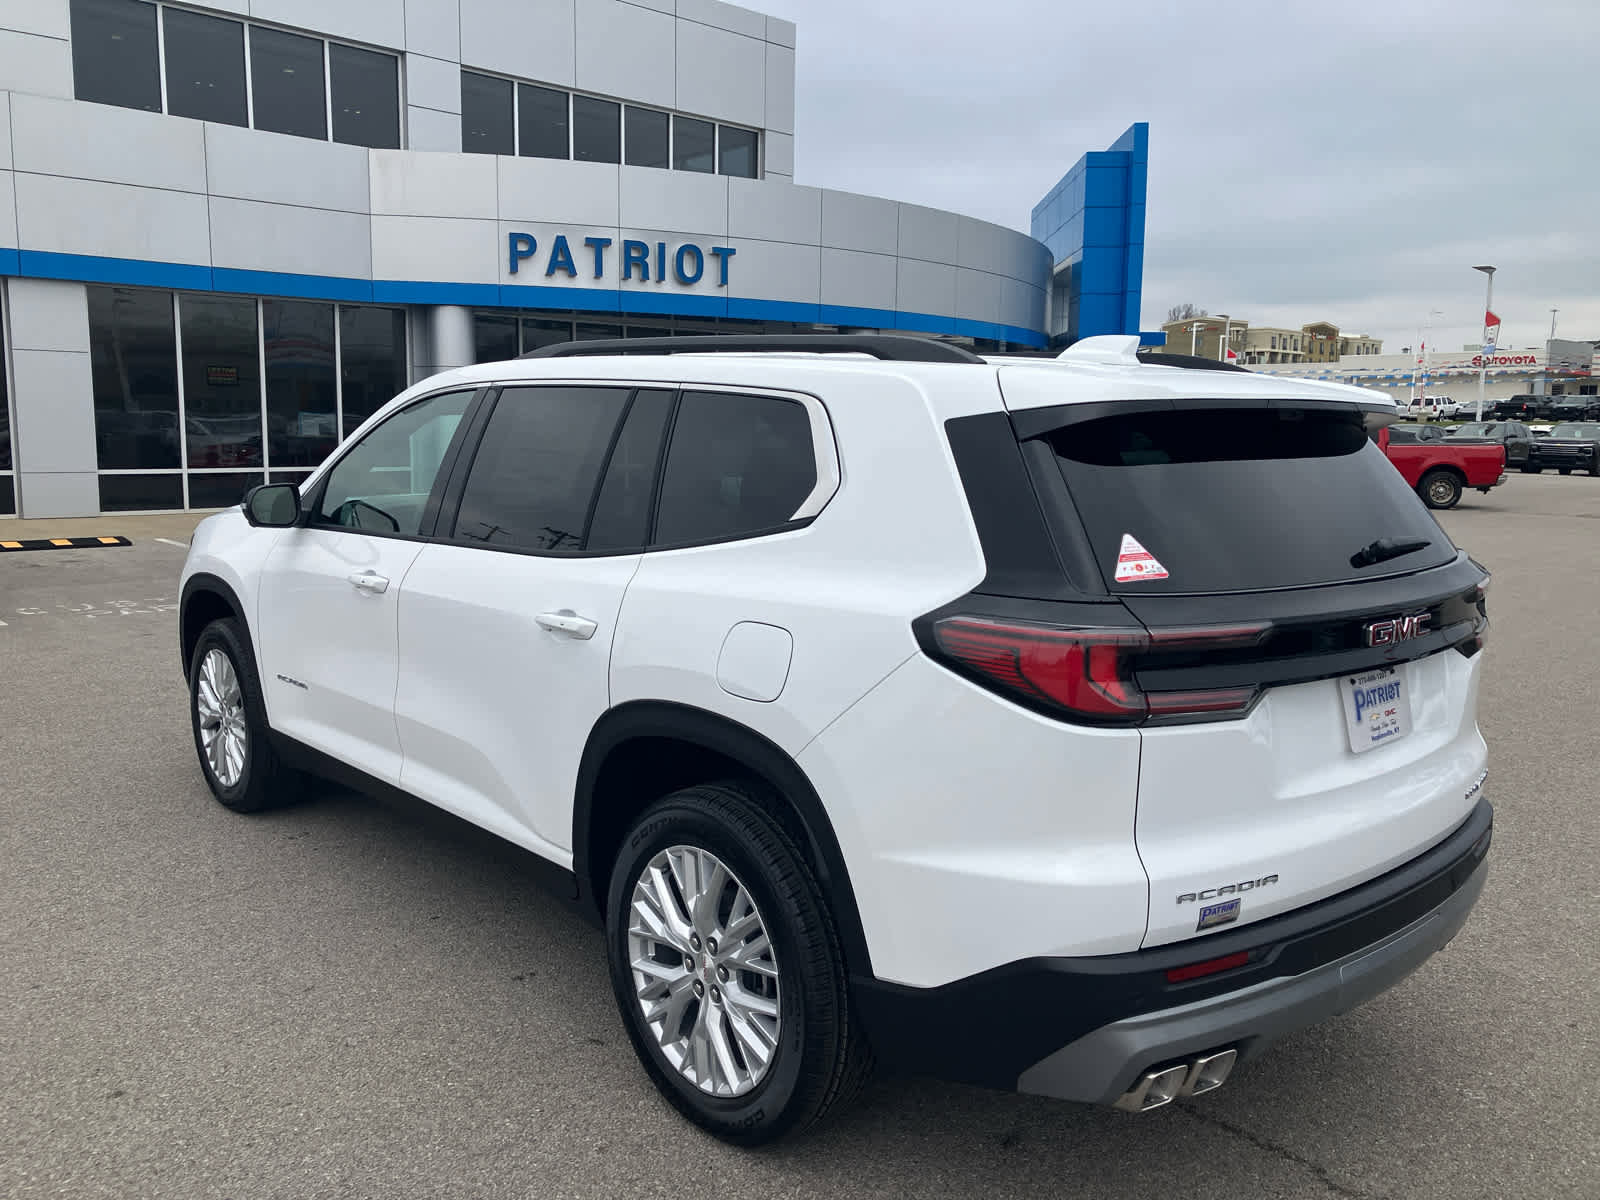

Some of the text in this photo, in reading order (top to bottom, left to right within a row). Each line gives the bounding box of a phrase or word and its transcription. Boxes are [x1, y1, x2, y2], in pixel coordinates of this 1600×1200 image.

[508, 232, 737, 287] PATRIOT
[1494, 355, 1537, 365] TOYOTA
[1369, 613, 1432, 647] GMC
[1353, 682, 1401, 722] PATRIOT
[1176, 874, 1280, 905] ACADIA
[1201, 901, 1241, 922] PATRIOT
